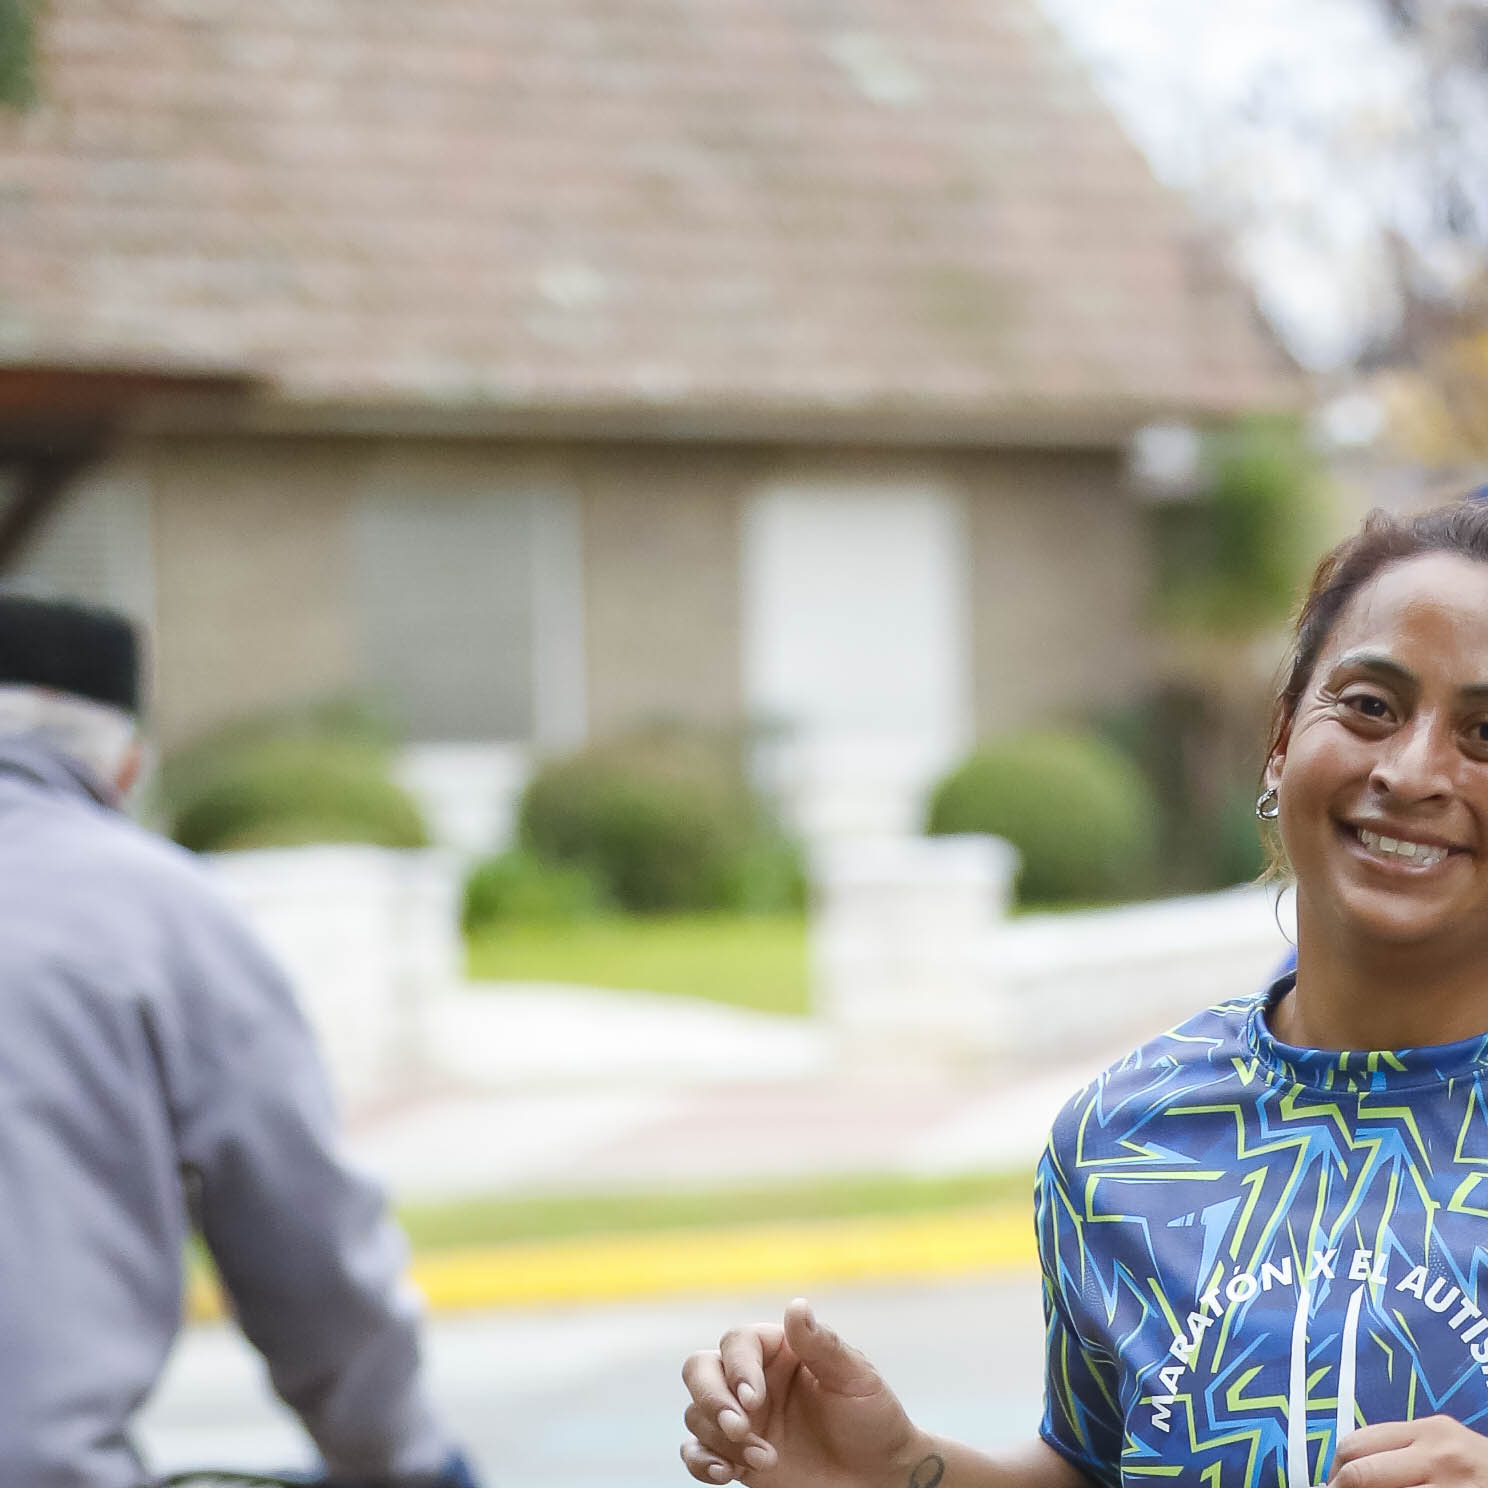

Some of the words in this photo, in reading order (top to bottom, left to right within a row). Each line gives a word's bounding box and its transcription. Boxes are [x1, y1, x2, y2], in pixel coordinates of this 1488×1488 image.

[1152, 1257, 1292, 1432] MARATÓN
[1310, 1249, 1338, 1281] X
[1349, 1249, 1388, 1285] EL
